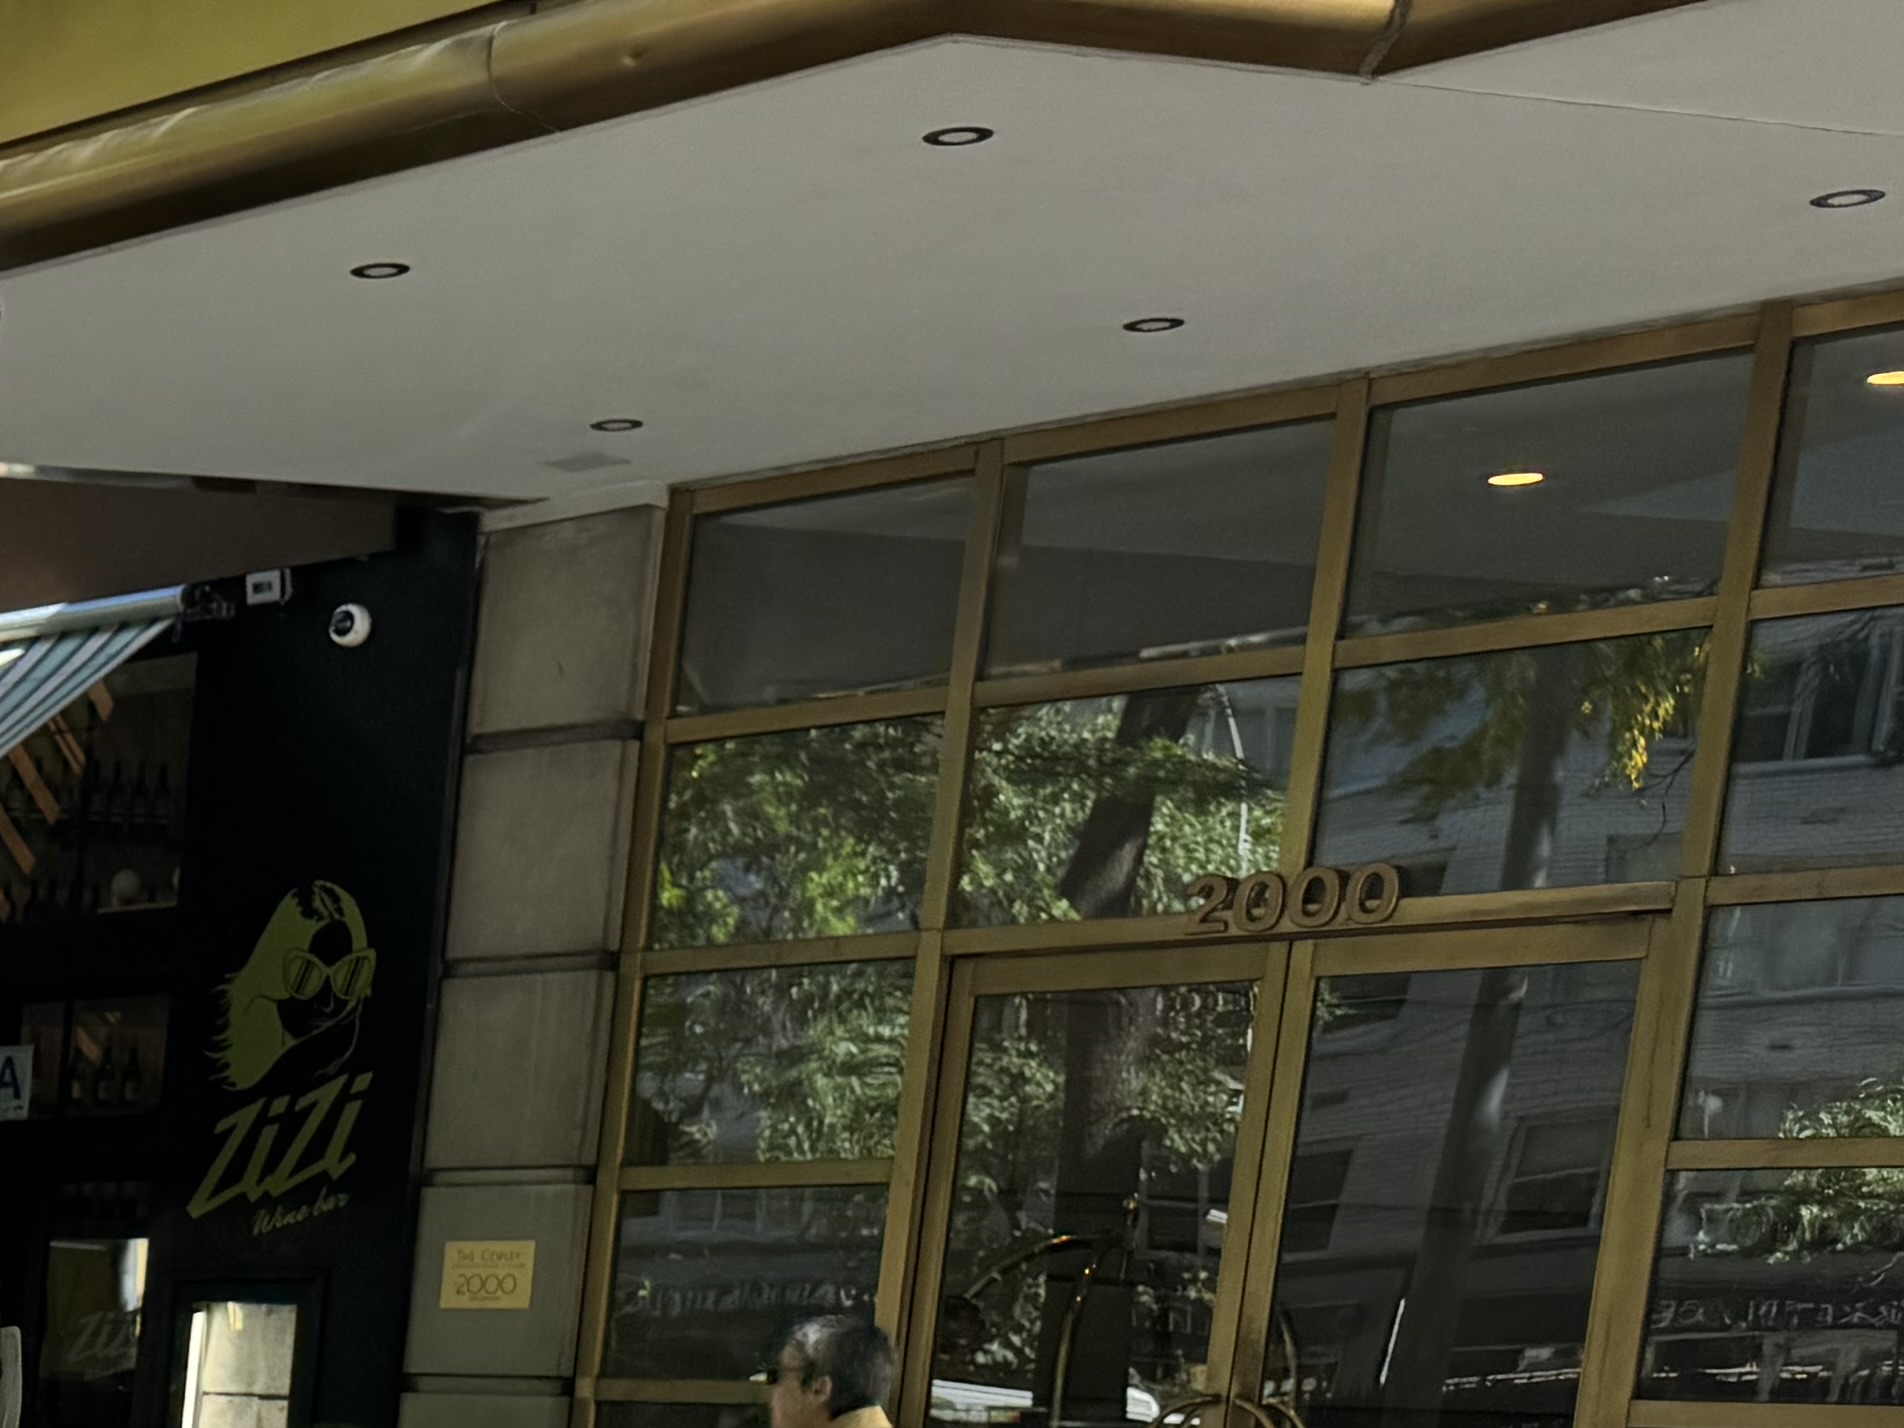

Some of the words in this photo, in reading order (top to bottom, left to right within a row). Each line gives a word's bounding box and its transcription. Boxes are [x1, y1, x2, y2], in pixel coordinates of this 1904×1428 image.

[1187, 863, 1399, 935] 2000
[252, 1205, 311, 1237] Wine
[455, 1273, 517, 1296] 2000
